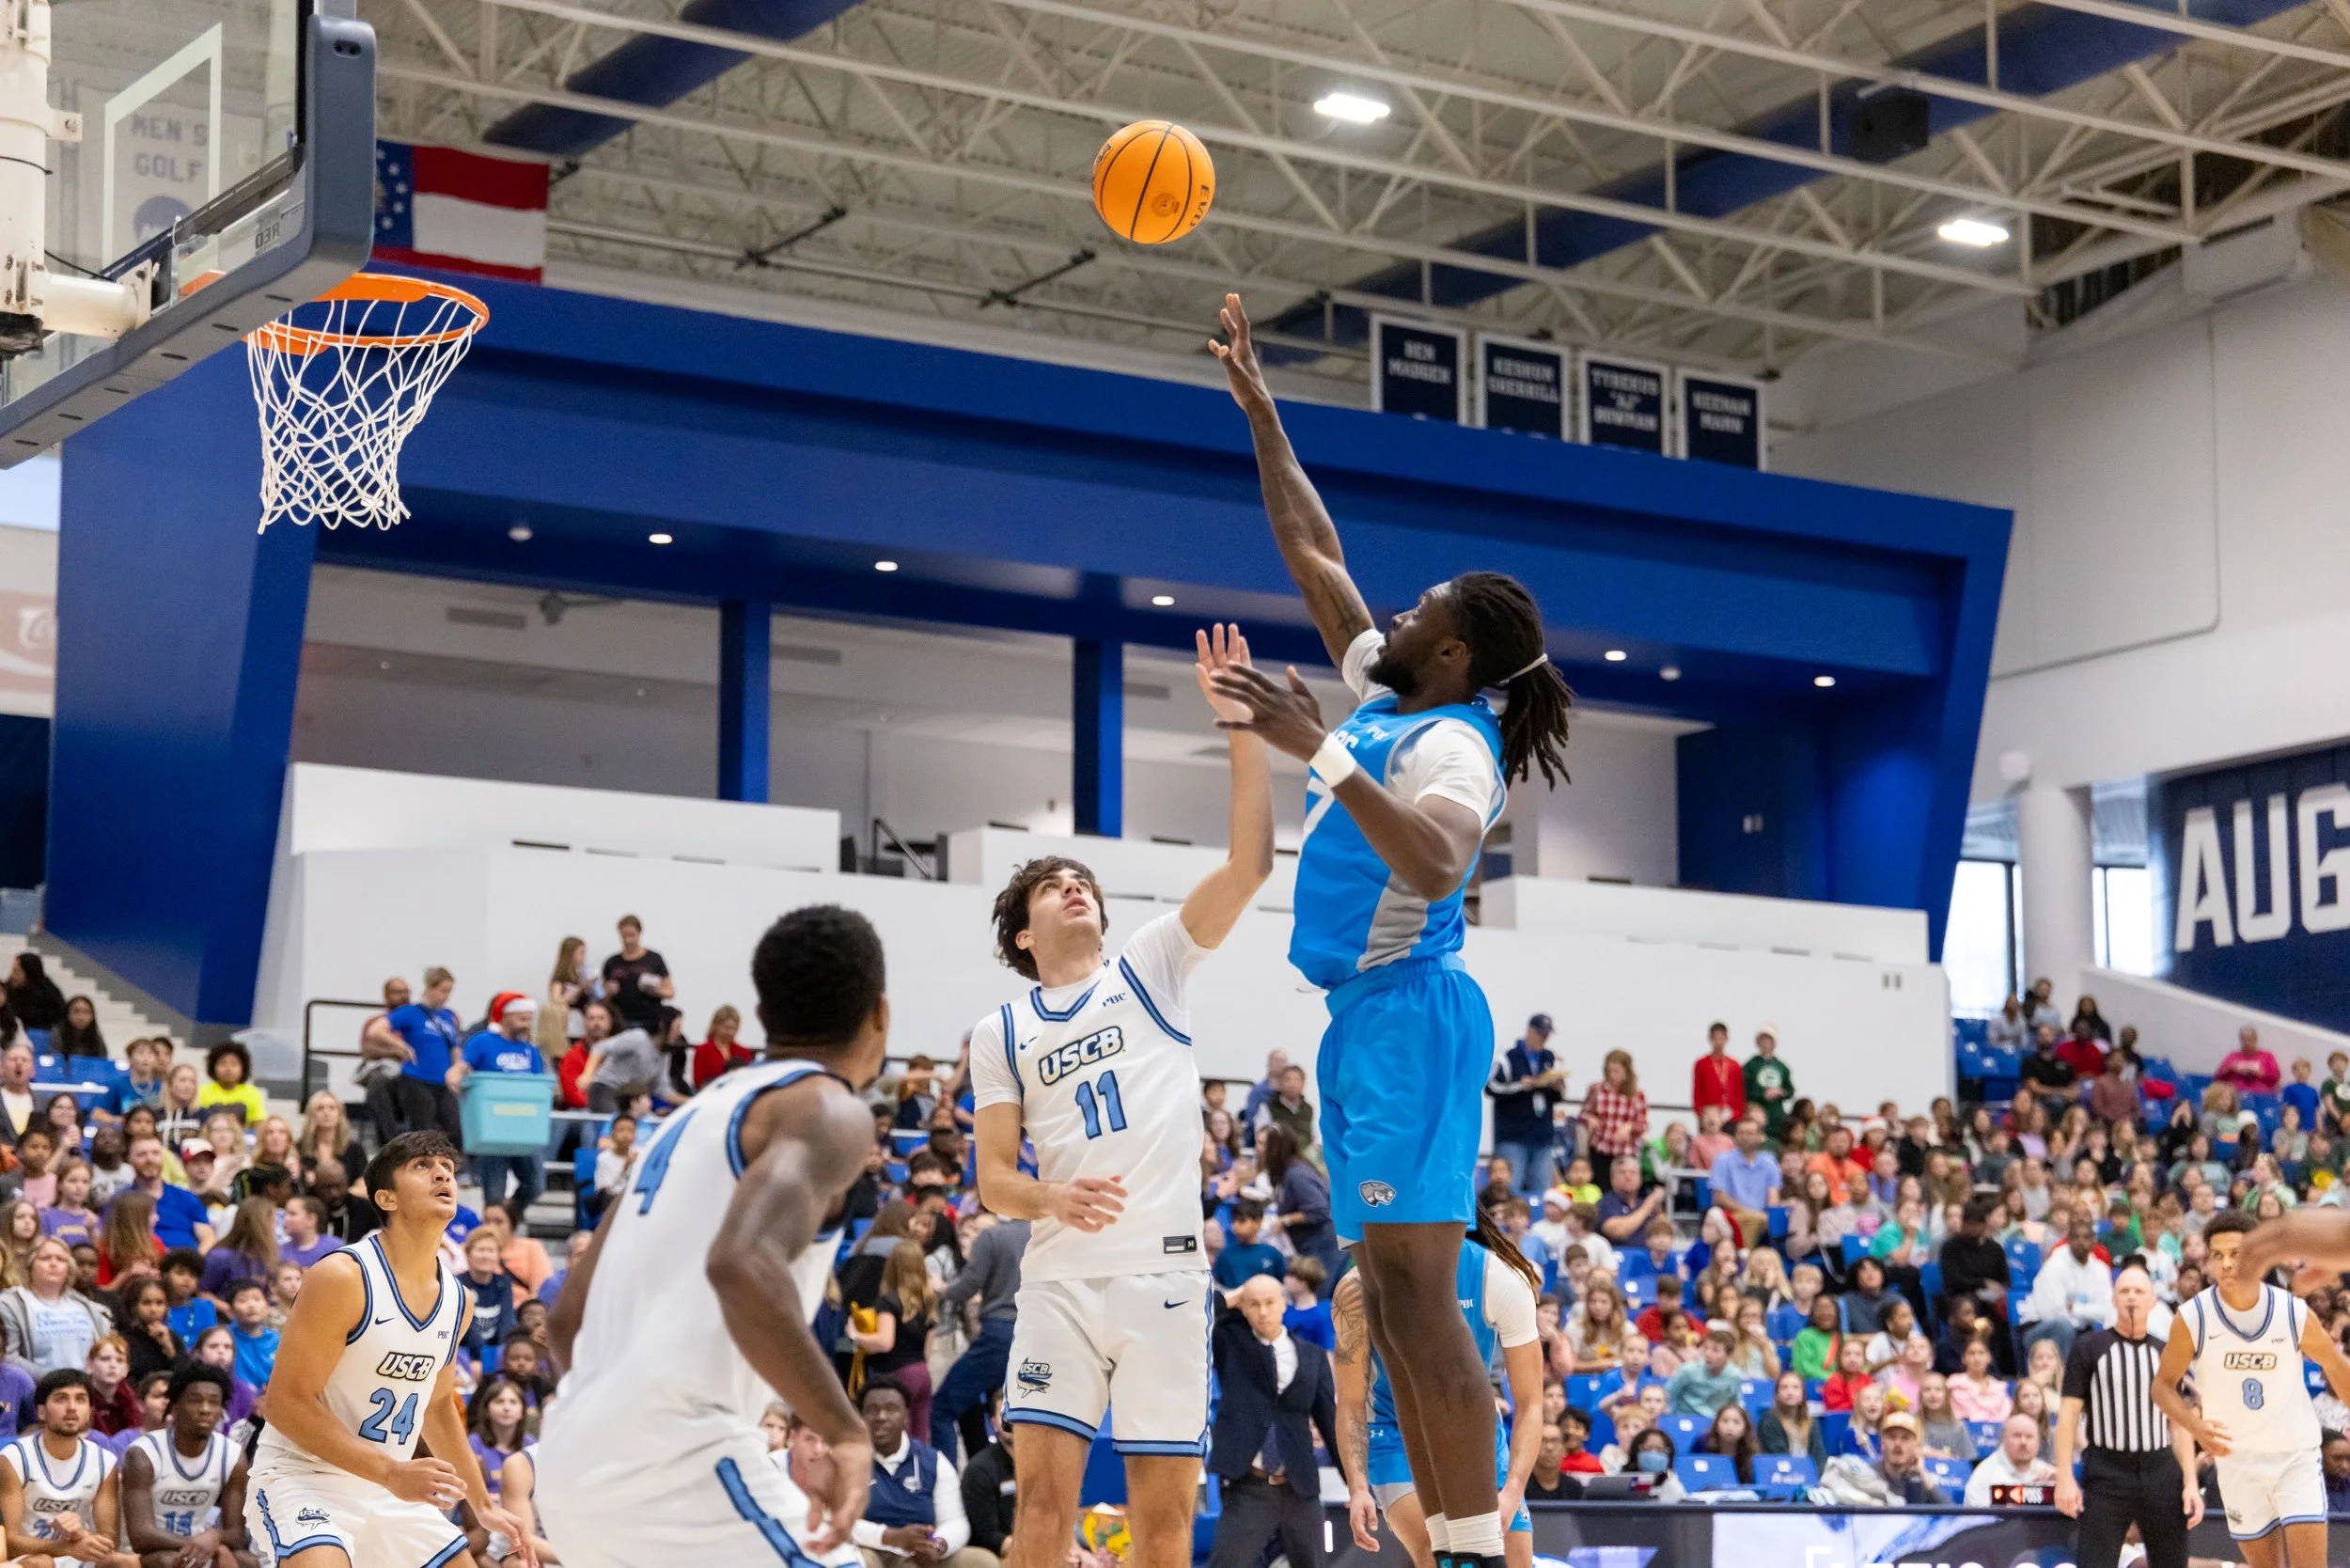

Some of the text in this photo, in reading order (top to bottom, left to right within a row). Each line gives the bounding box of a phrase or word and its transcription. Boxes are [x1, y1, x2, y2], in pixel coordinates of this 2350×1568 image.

[131, 114, 208, 147] MEN'S
[134, 152, 204, 184] GOLF
[1403, 339, 1436, 363] BEN
[1039, 1026, 1124, 1086] USCB
[1074, 1070, 1128, 1140] 11
[634, 1107, 699, 1215] 4
[376, 1351, 435, 1381] USCB
[2224, 1352, 2277, 1370] USCB
[2242, 1378, 2264, 1410] 8
[358, 1388, 419, 1445] 24
